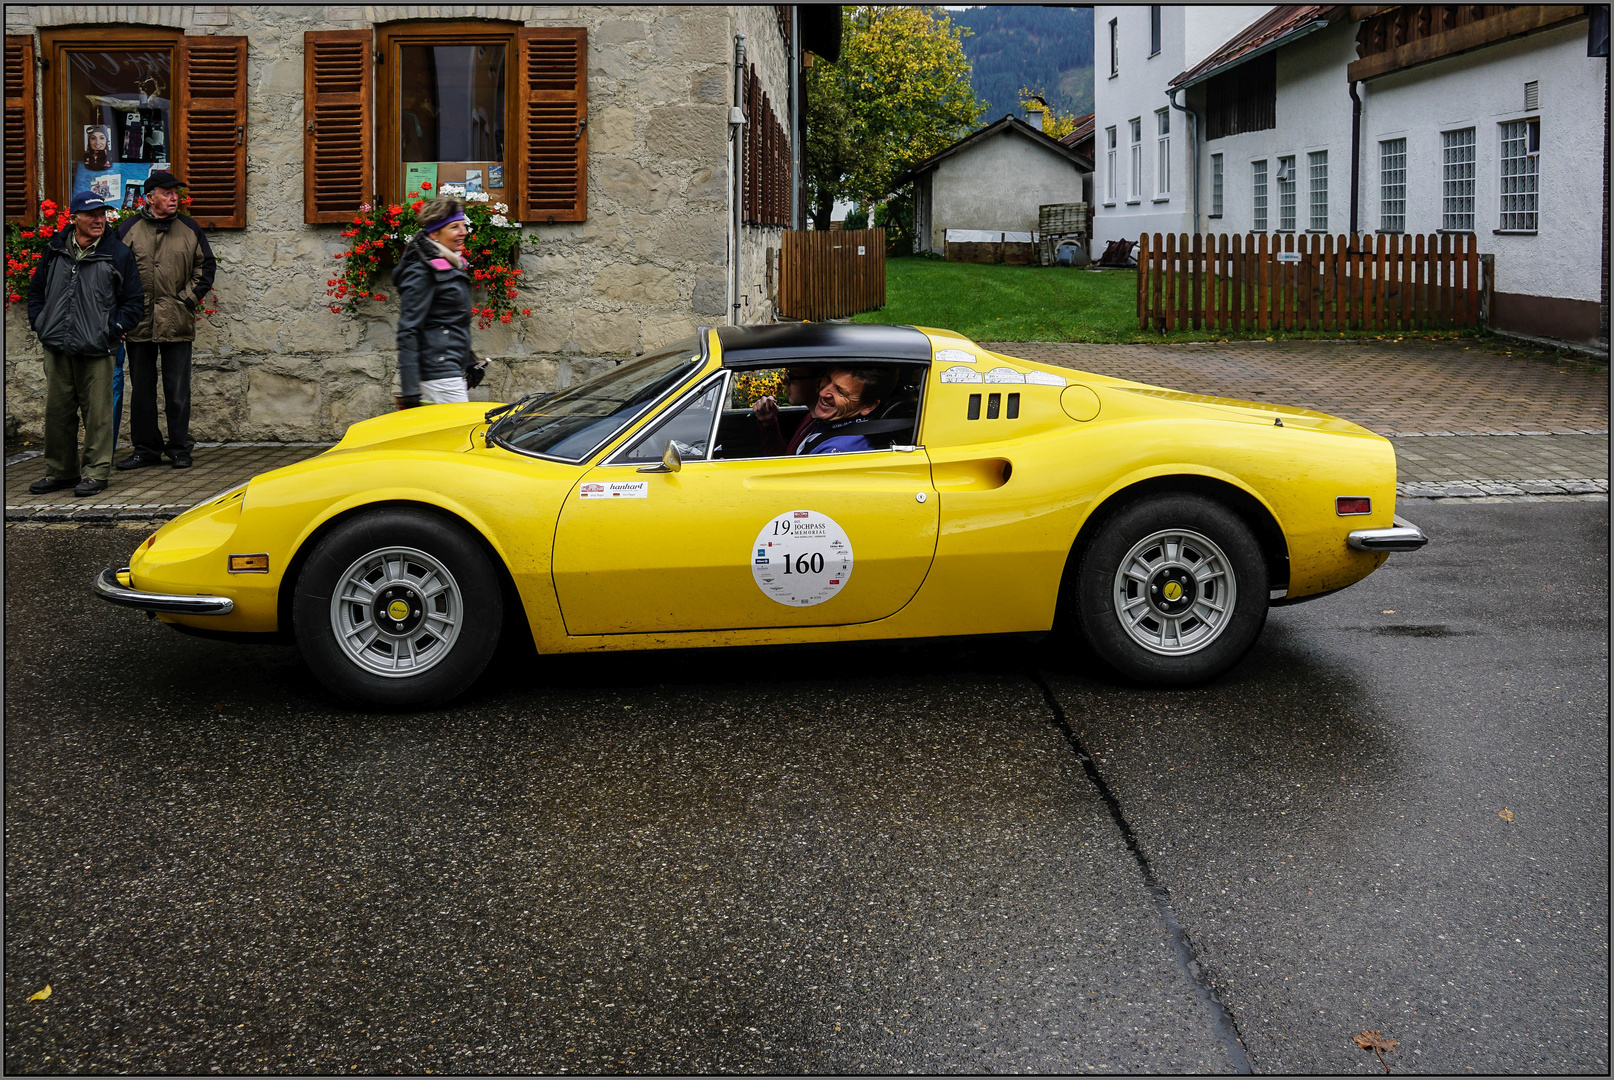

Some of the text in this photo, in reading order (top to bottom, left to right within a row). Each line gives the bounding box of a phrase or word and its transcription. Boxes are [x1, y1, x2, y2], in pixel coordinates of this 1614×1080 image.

[609, 482, 643, 490] hanhart
[773, 519, 794, 536] 19.
[794, 523, 826, 531] JOCHPASS
[783, 552, 825, 575] 160
